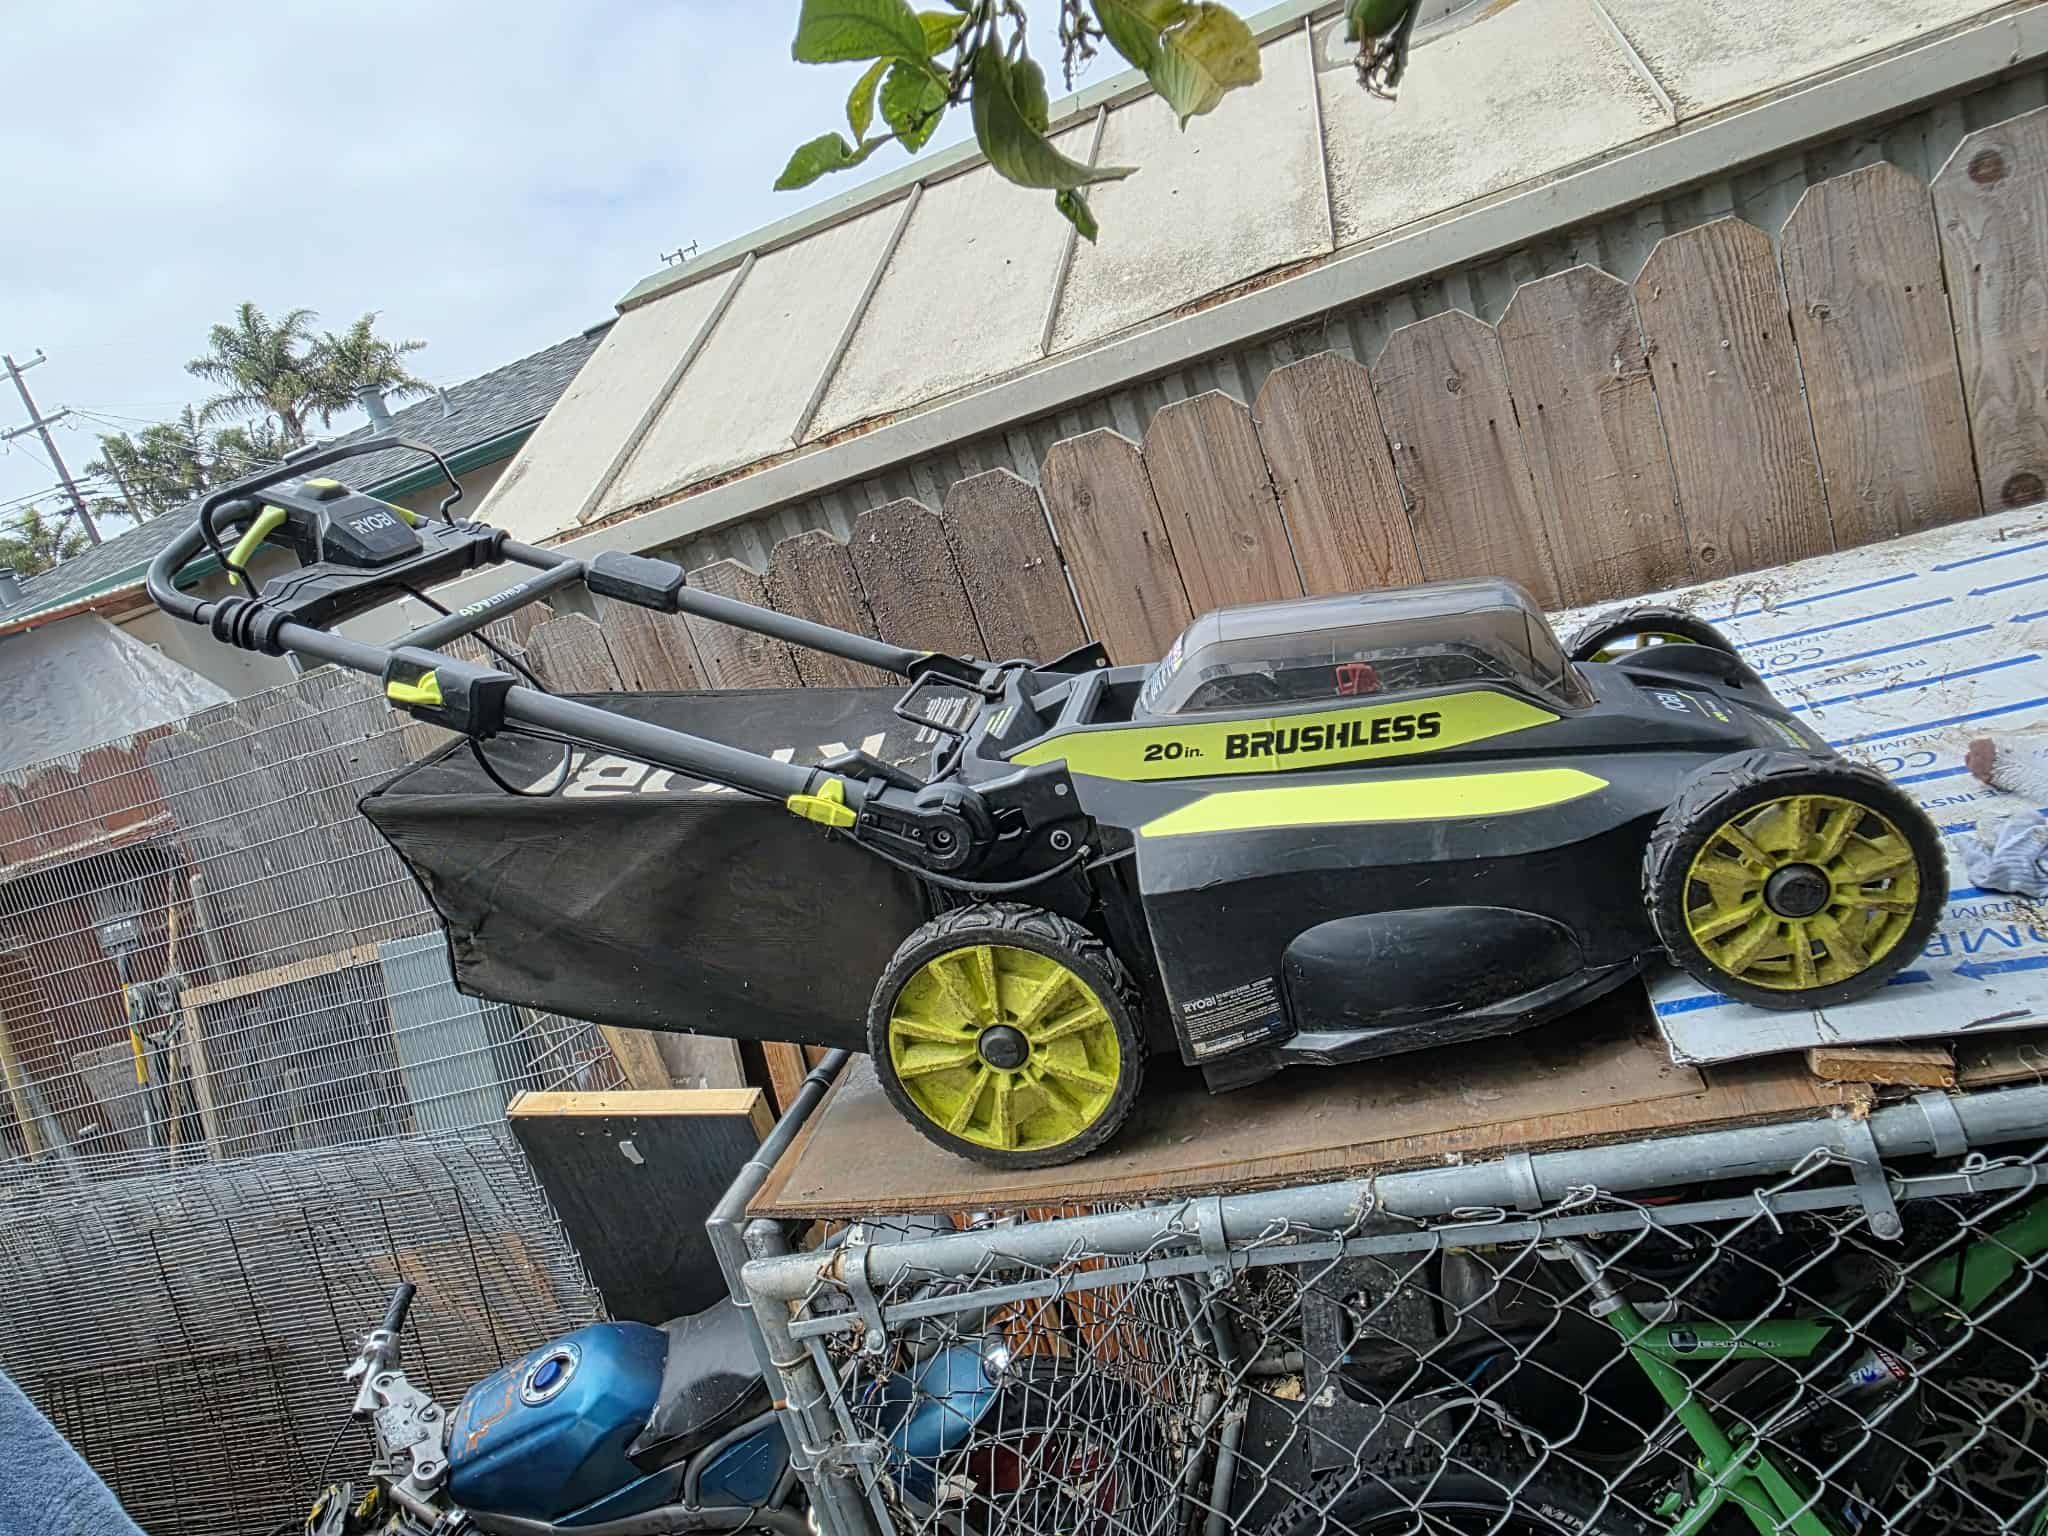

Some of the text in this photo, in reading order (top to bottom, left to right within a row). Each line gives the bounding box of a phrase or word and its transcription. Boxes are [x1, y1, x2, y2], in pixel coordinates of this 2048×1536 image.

[350, 511, 397, 535] RYOBI
[1225, 711, 1442, 760] BRUSHLESS
[1183, 995, 1217, 1014] RYOBI
